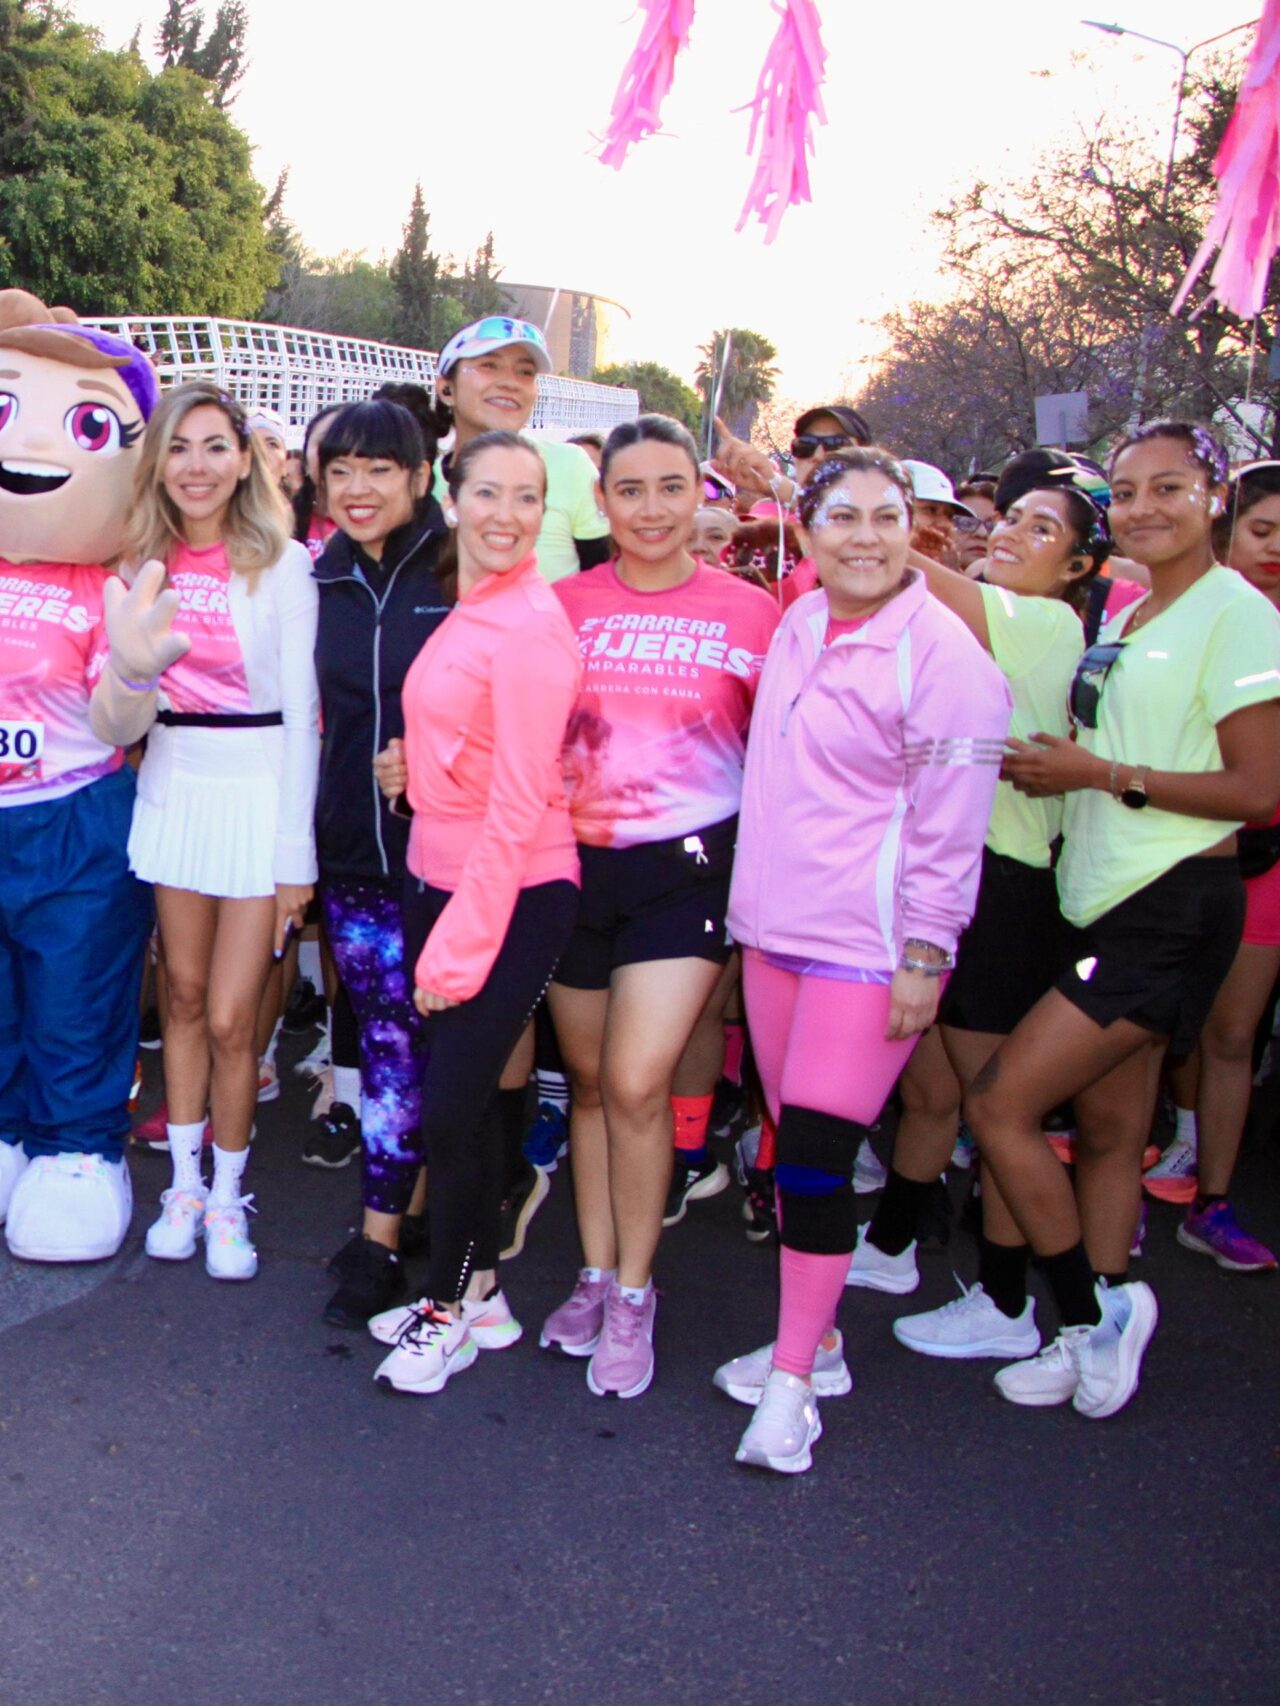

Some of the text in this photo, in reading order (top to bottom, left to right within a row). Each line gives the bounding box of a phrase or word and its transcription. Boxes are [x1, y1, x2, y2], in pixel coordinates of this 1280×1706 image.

[604, 614, 727, 639] CARRERA
[577, 631, 752, 677] UJERES
[634, 685, 659, 695] CON
[662, 687, 702, 700] CAUSA
